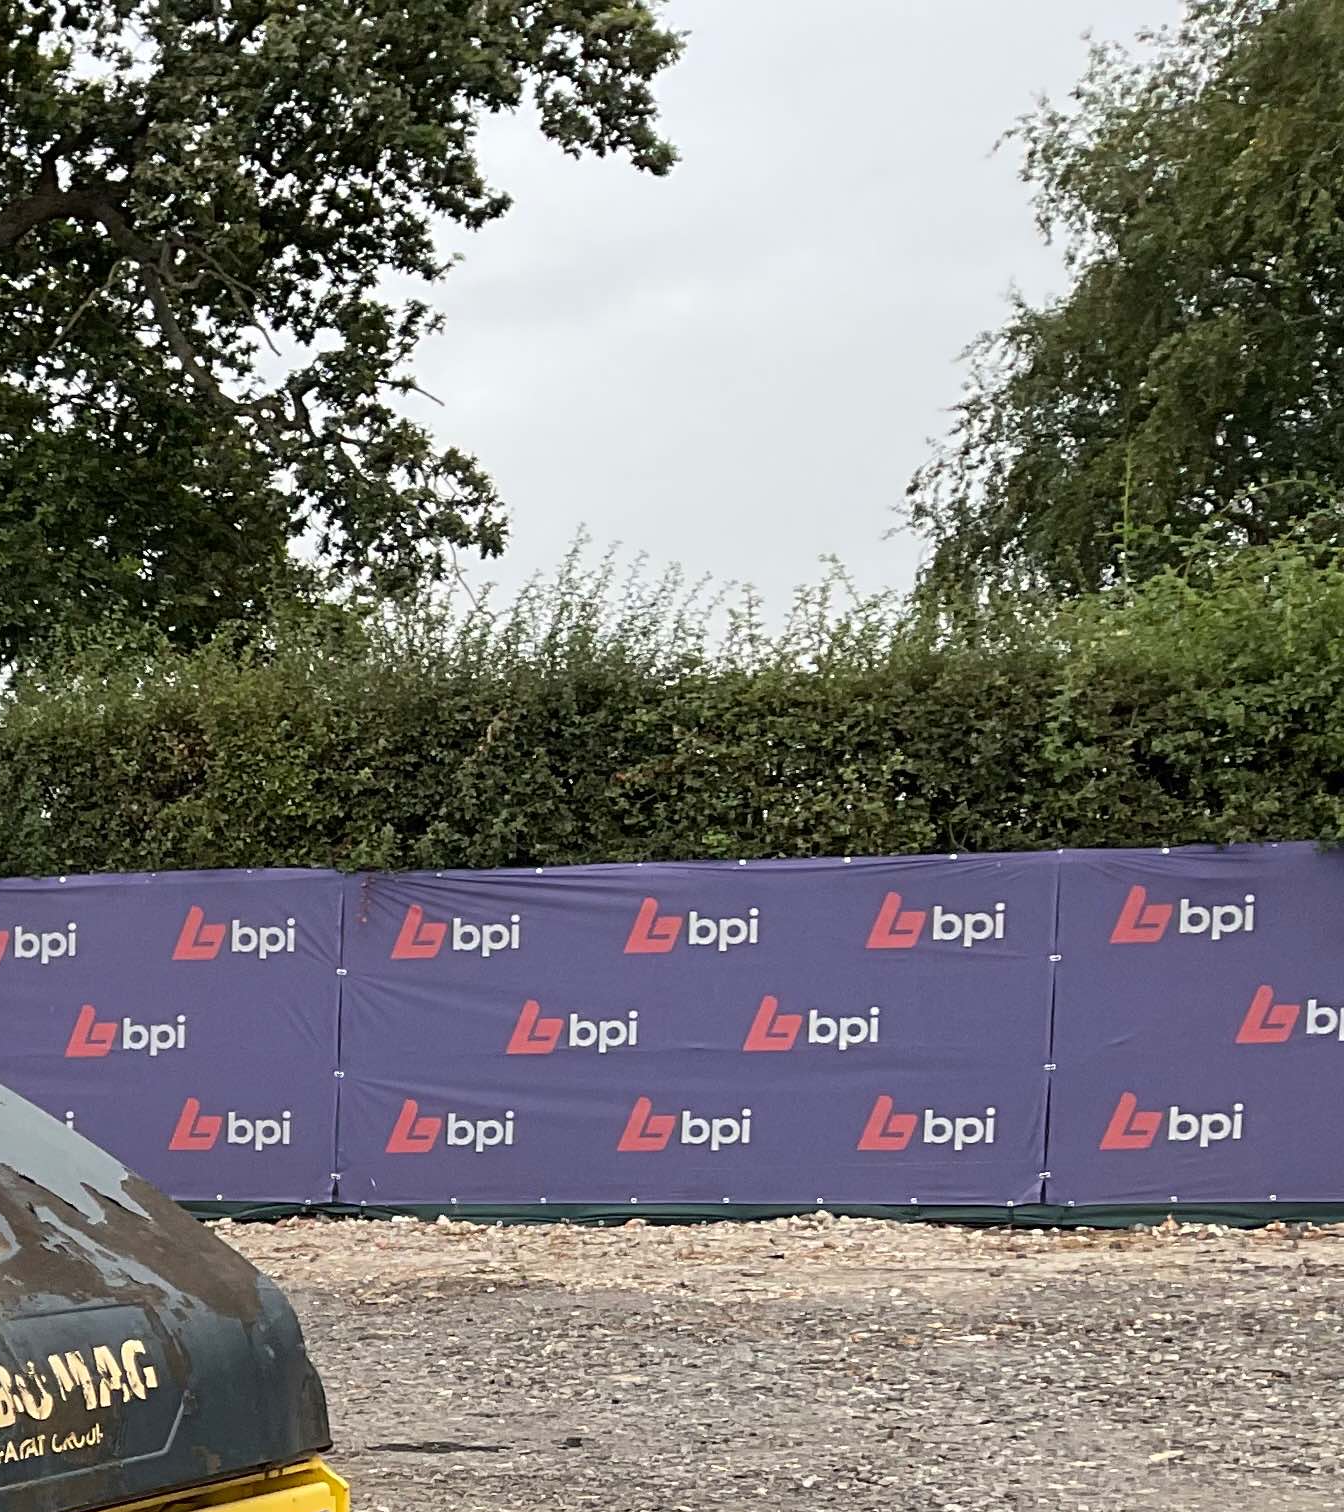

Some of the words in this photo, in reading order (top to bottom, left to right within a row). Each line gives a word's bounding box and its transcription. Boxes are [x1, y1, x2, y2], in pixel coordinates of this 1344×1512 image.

[232, 917, 295, 960] bpi
[452, 914, 520, 957] bpi
[689, 907, 759, 952] bpi
[933, 902, 1005, 947] bpi
[1179, 894, 1255, 941] bpi
[15, 922, 76, 965] bpi
[123, 1014, 186, 1057] bpi
[568, 1010, 638, 1054] bpi
[808, 1006, 879, 1050] bpi
[227, 1110, 291, 1151] bpi
[447, 1110, 515, 1153] bpi
[681, 1108, 752, 1151] bpi
[923, 1107, 996, 1151] bpi
[1167, 1103, 1243, 1148] bpi
